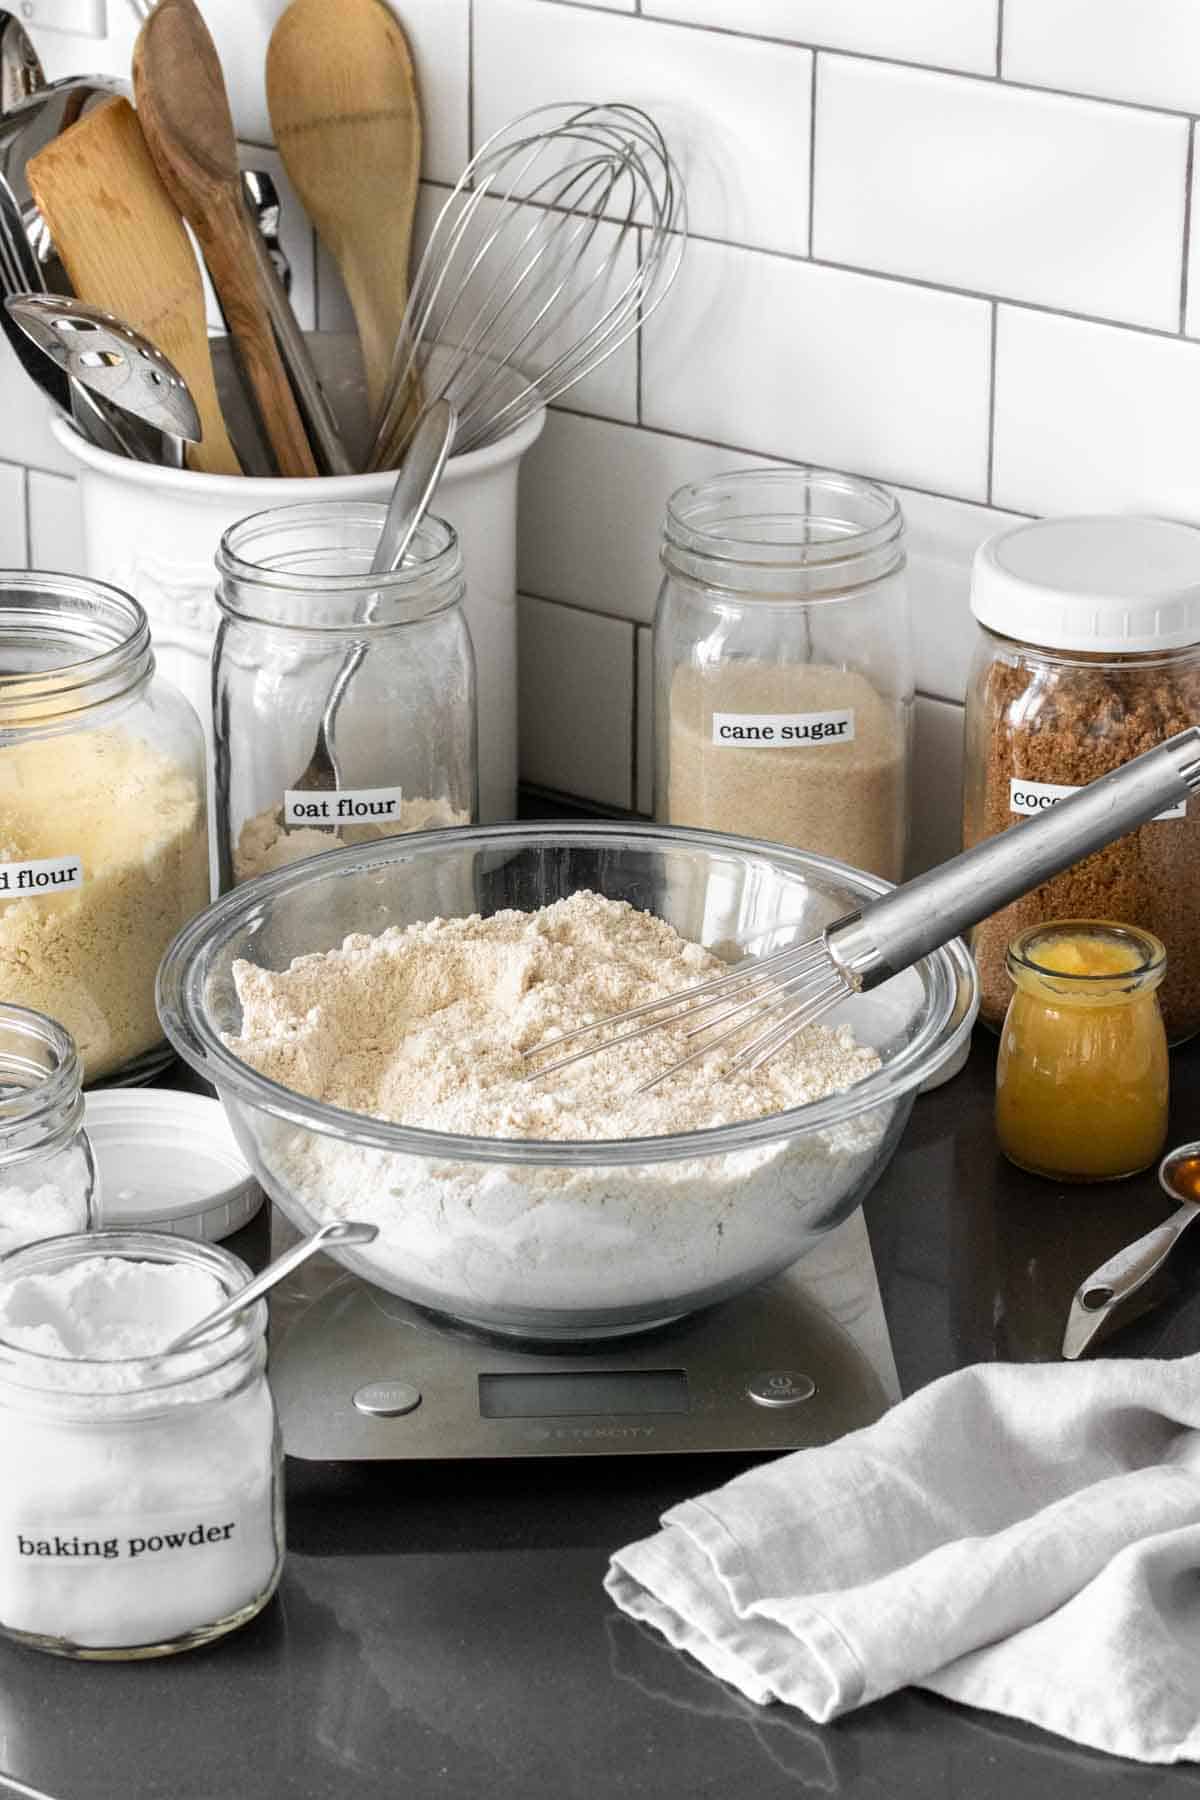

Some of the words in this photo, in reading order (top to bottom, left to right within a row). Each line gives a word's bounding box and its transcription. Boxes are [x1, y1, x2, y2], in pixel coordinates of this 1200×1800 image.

[719, 725, 775, 740] cane
[780, 720, 848, 741] sugar
[292, 800, 330, 818] oat
[336, 798, 397, 817] flour
[16, 866, 78, 889] flour
[17, 1534, 119, 1559] baking
[127, 1521, 235, 1557] powder
